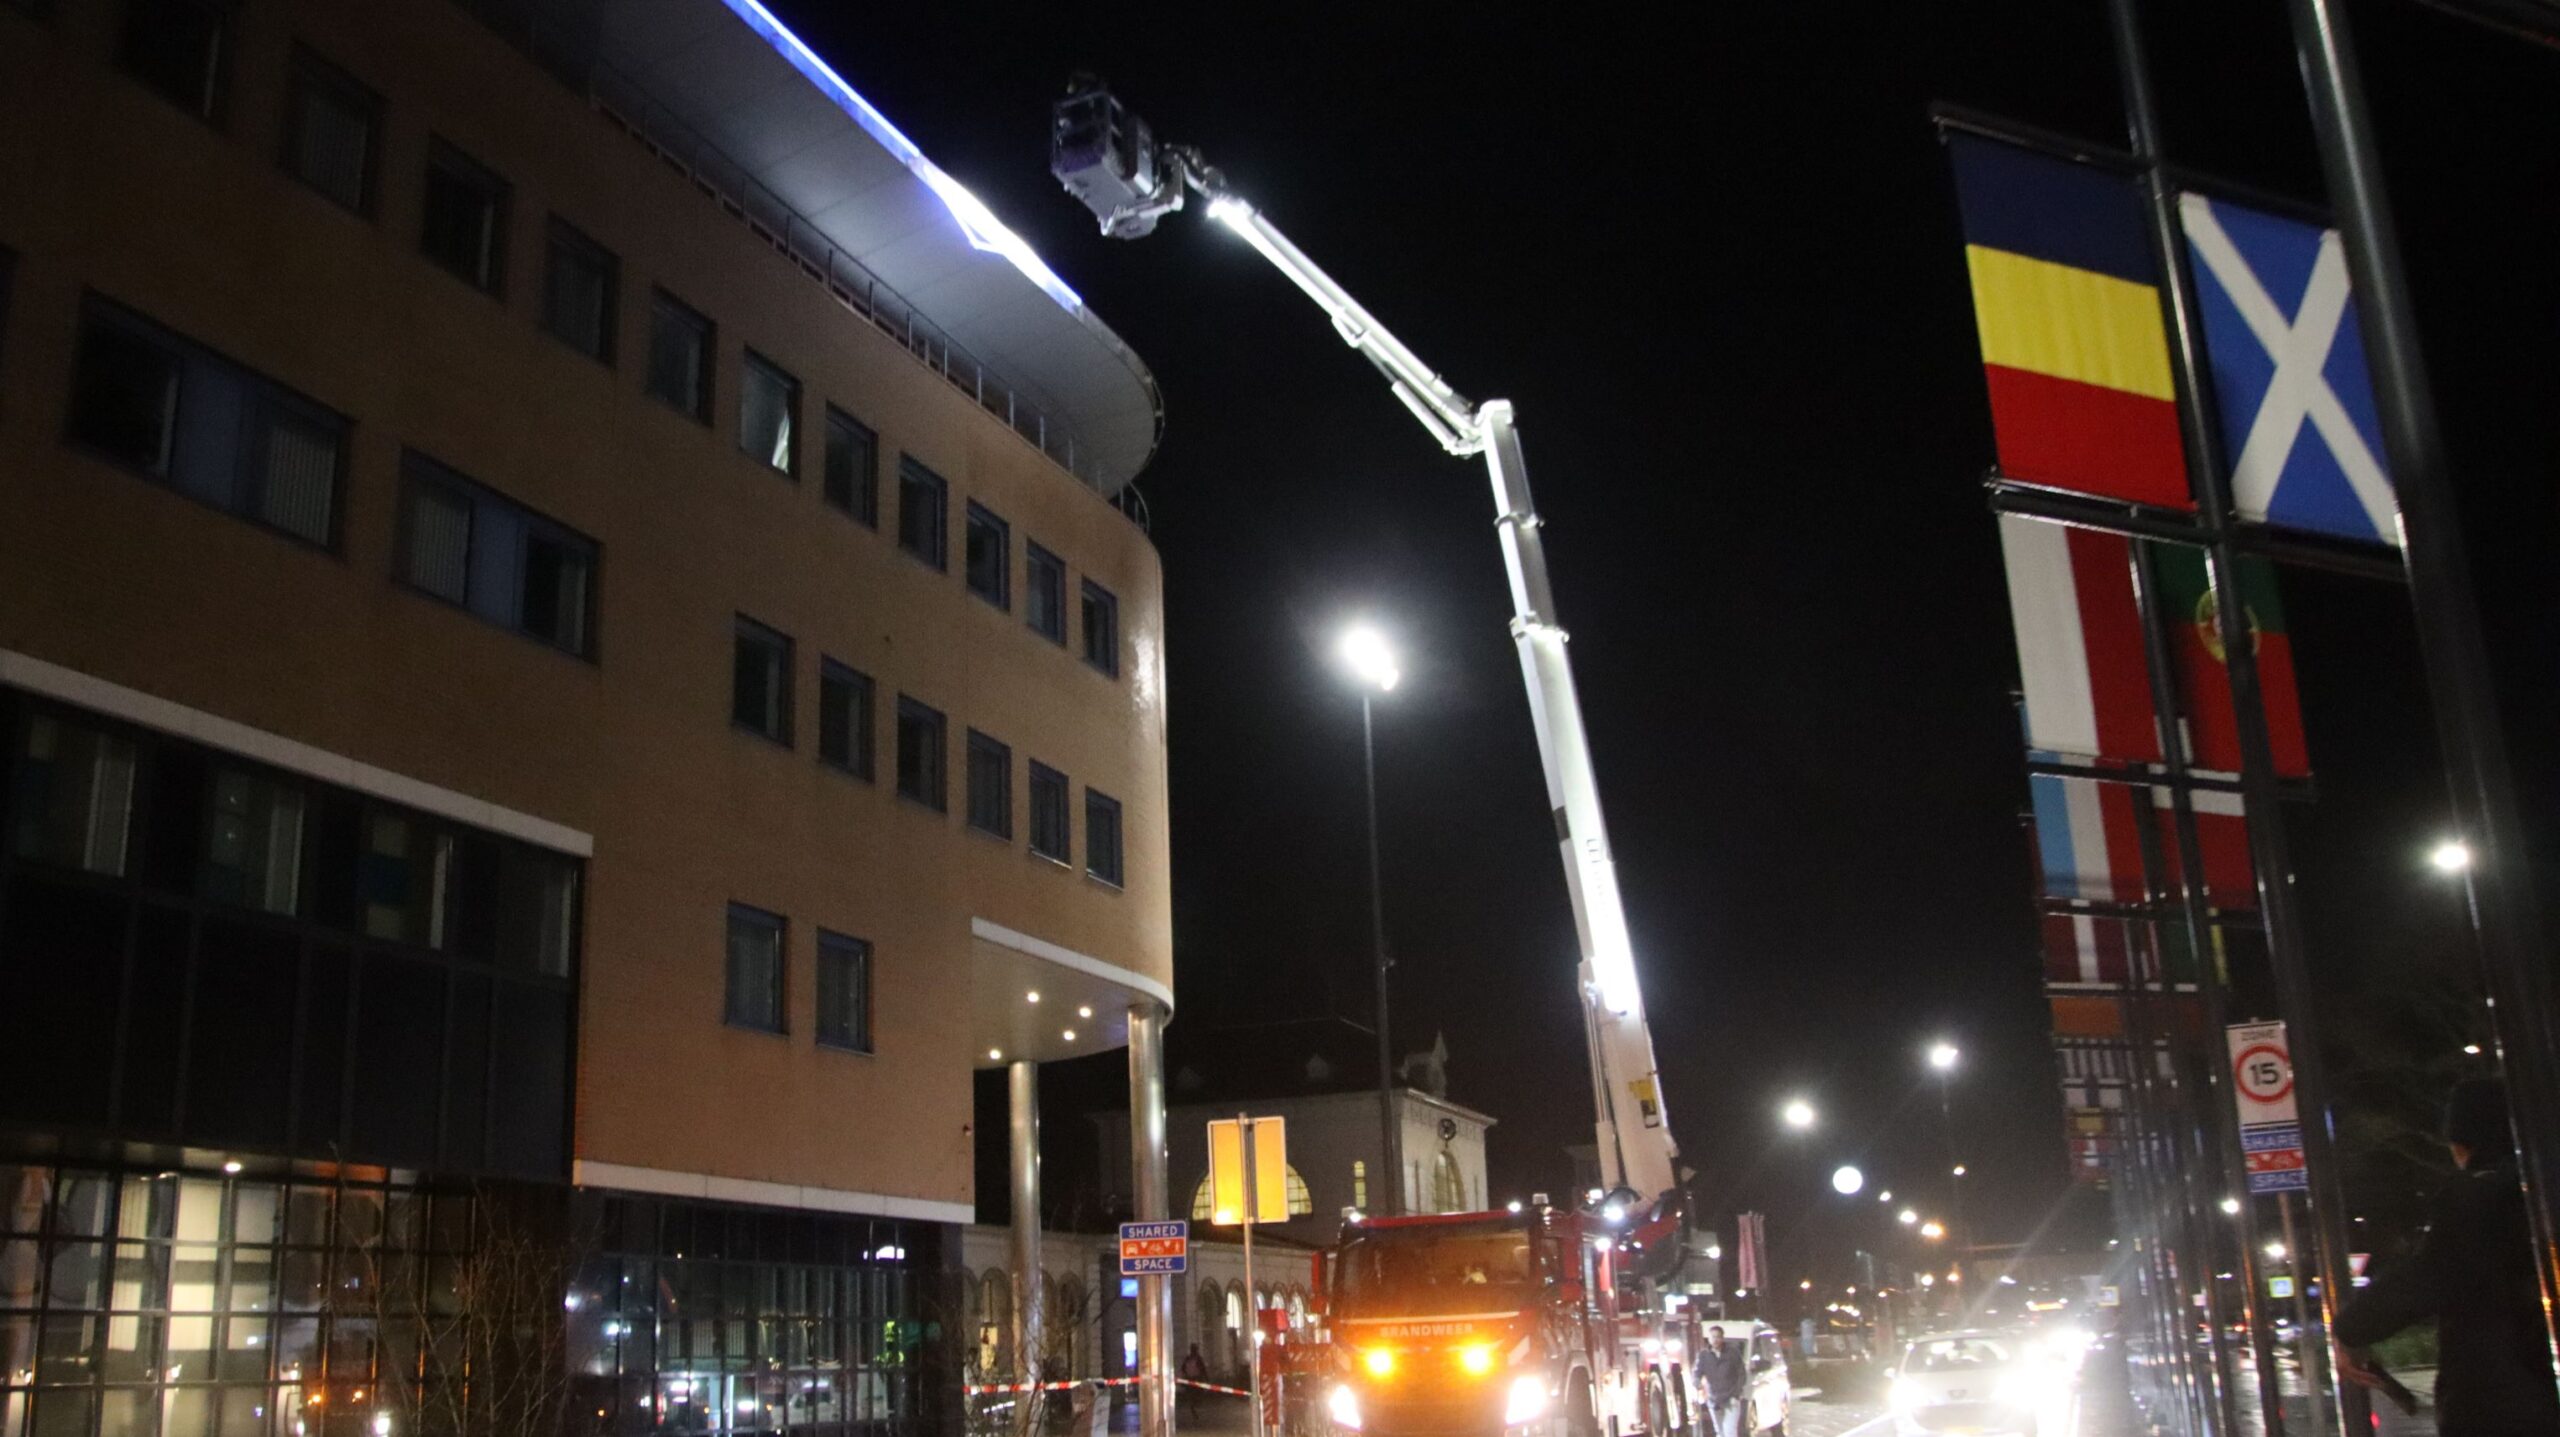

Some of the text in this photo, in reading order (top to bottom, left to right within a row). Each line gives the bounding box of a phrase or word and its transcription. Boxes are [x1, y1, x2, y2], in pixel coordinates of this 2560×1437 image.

[2249, 1062, 2280, 1086] 15
[2242, 1133, 2302, 1150] SHARE
[1128, 1225, 1178, 1238] SHARED
[1134, 1258, 1172, 1270] SPACE
[1380, 1323, 1473, 1338] BRANDWEER
